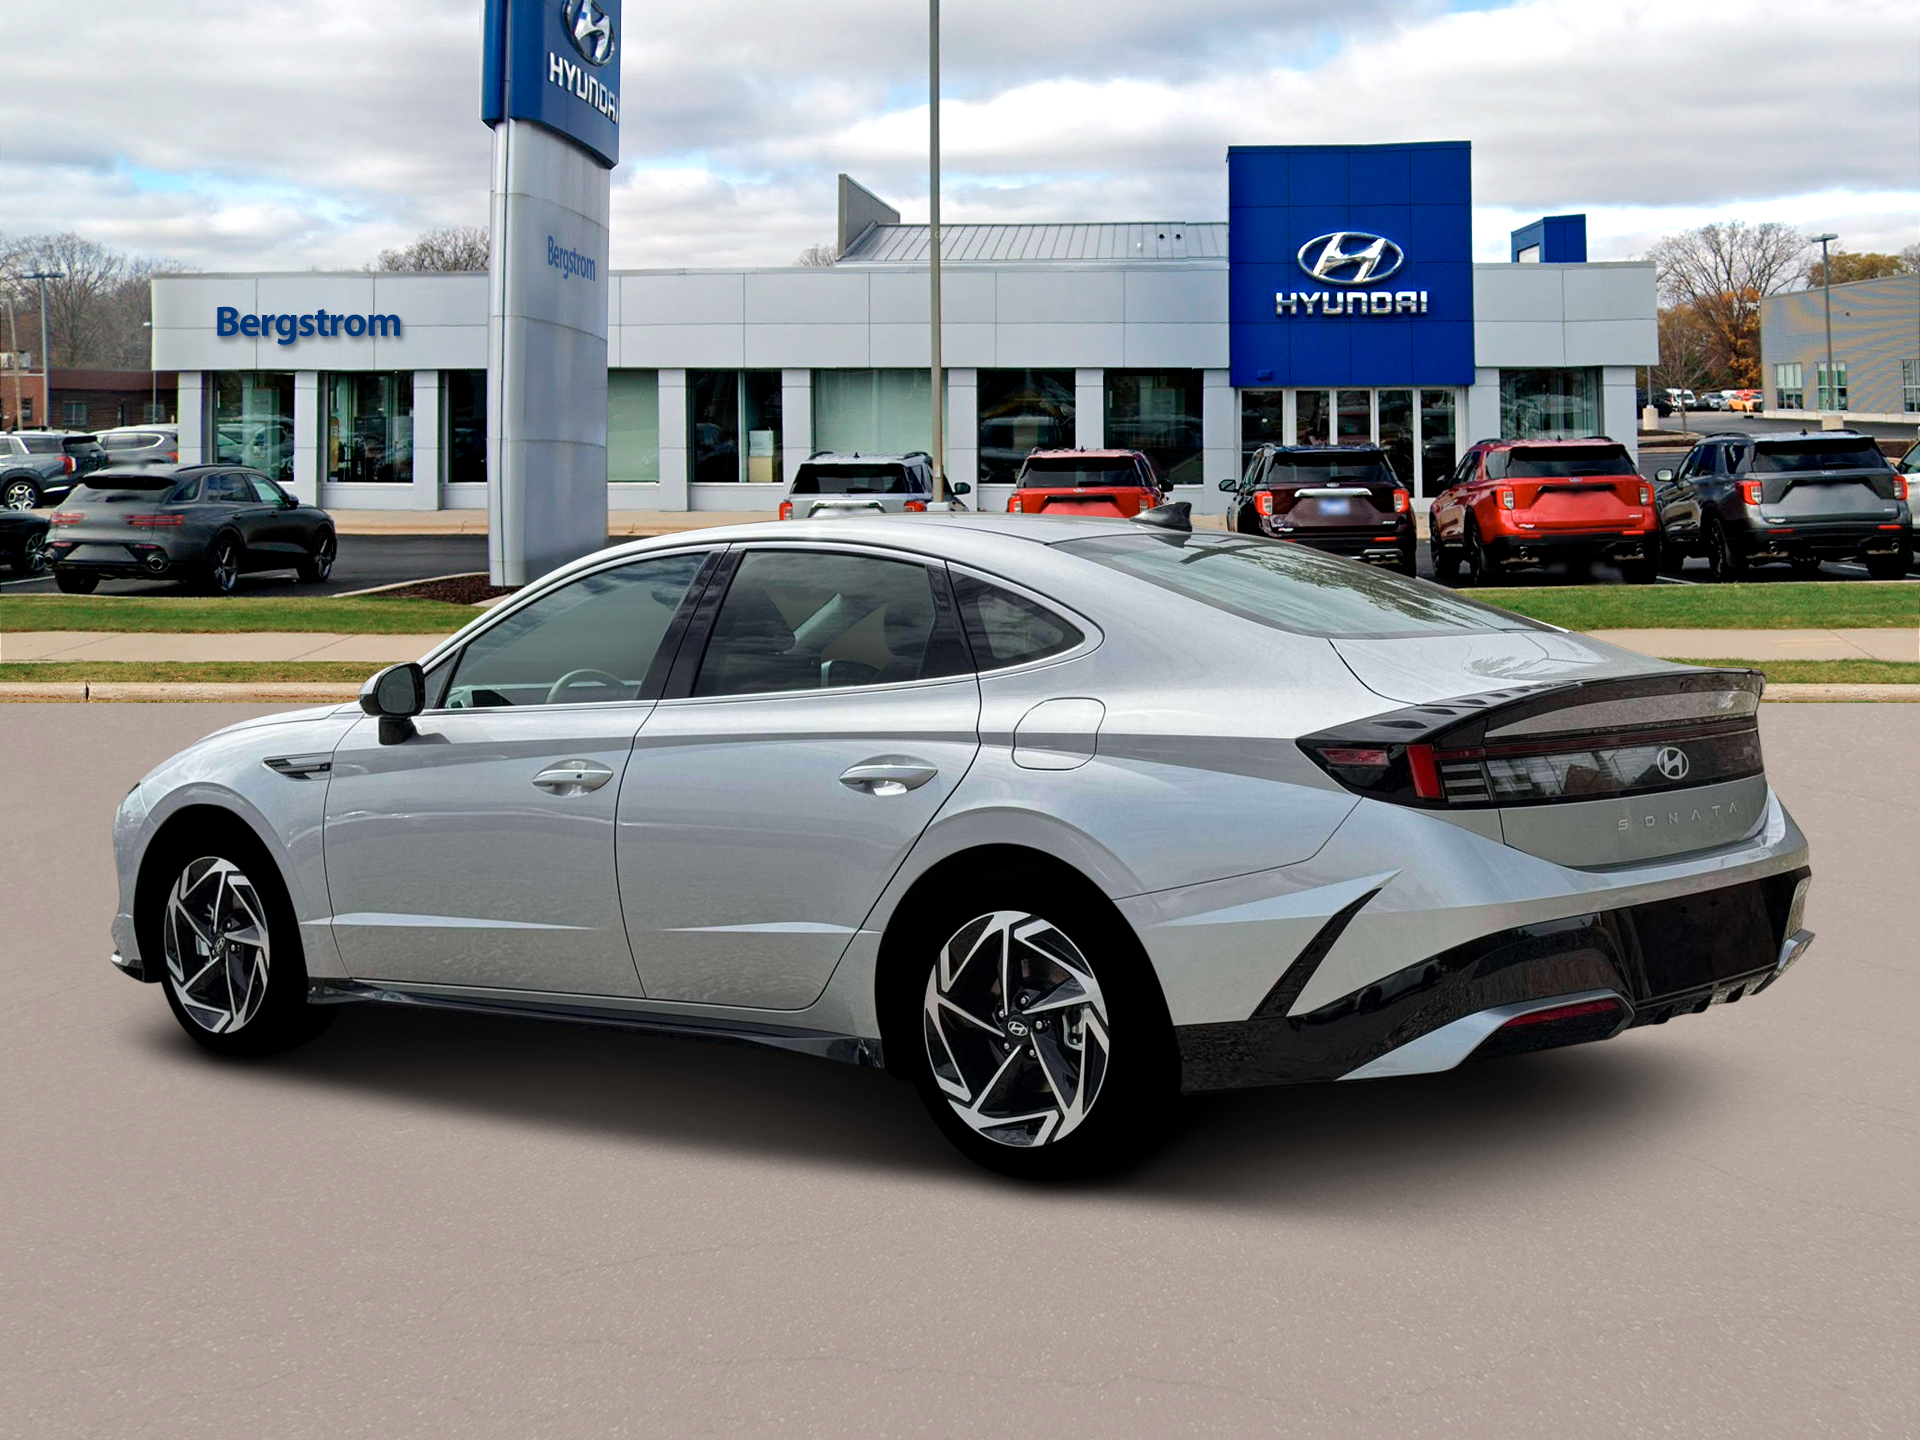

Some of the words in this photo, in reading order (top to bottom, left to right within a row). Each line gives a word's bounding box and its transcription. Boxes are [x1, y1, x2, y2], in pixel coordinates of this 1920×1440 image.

[548, 52, 619, 124] HYUNDAI
[547, 235, 596, 282] Bergstrom
[1275, 291, 1428, 315] HYUNDAI
[216, 306, 402, 346] Bergstrom
[1617, 802, 1738, 831] SONATA
